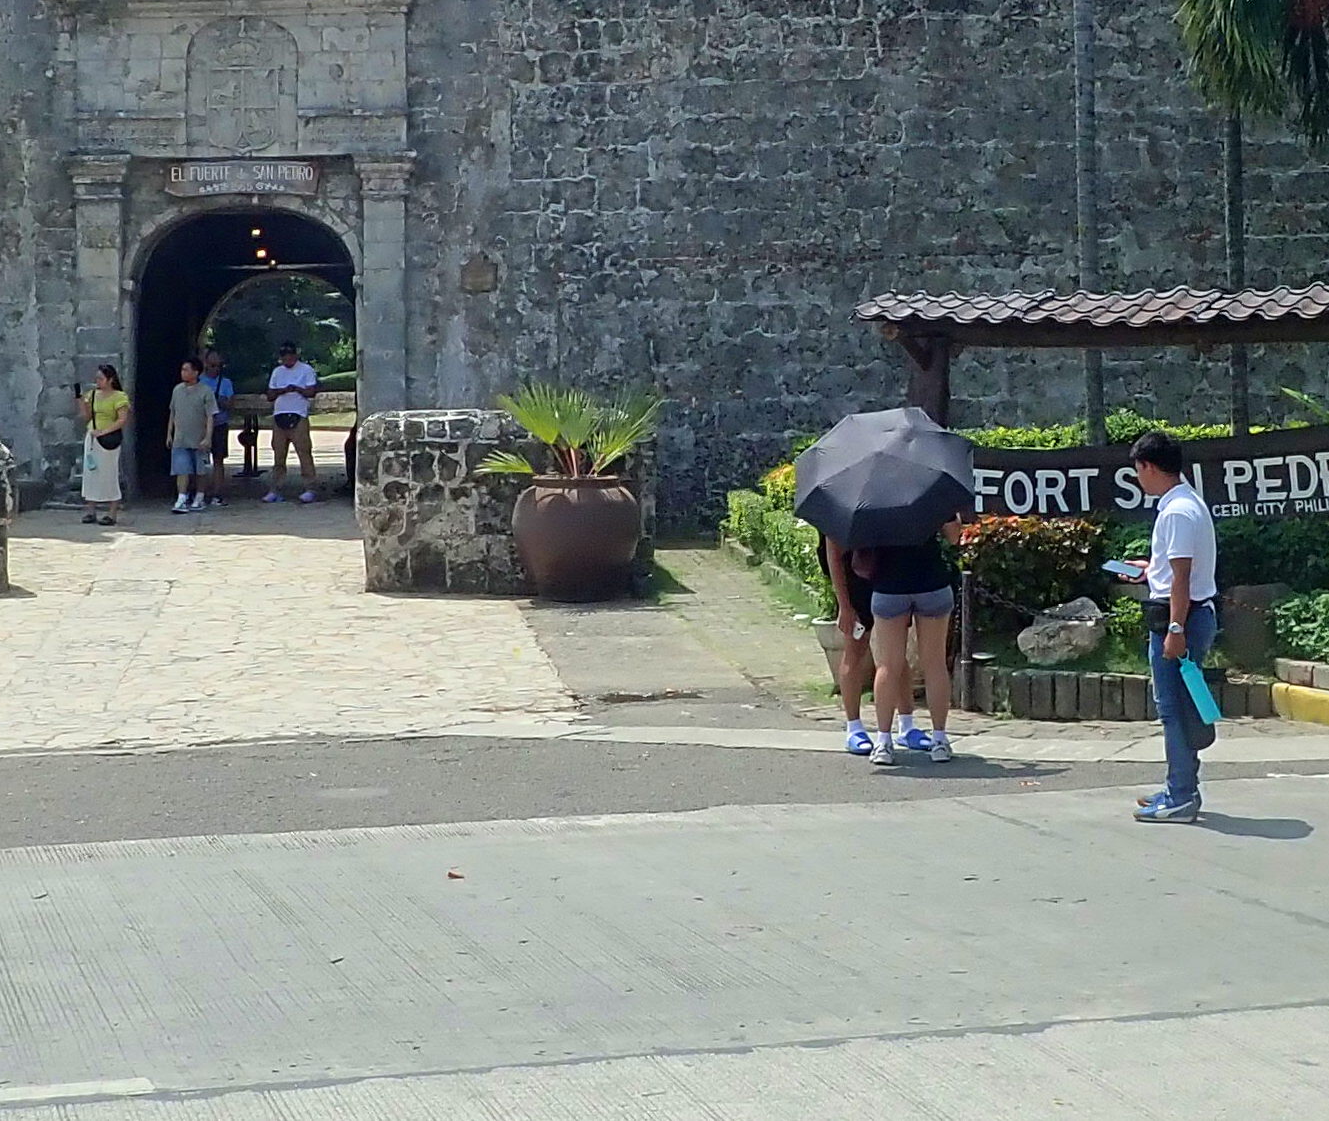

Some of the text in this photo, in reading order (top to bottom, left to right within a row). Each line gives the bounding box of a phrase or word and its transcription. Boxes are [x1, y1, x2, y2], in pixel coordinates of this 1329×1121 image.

[171, 167, 186, 182] EL
[190, 165, 232, 181] FUERTE
[253, 165, 274, 181] SAN
[277, 165, 314, 181] PEDRO
[972, 467, 1100, 515] FORT
[1113, 463, 1205, 510] SN
[1212, 503, 1249, 517] CEBU
[1255, 502, 1288, 516] CITY
